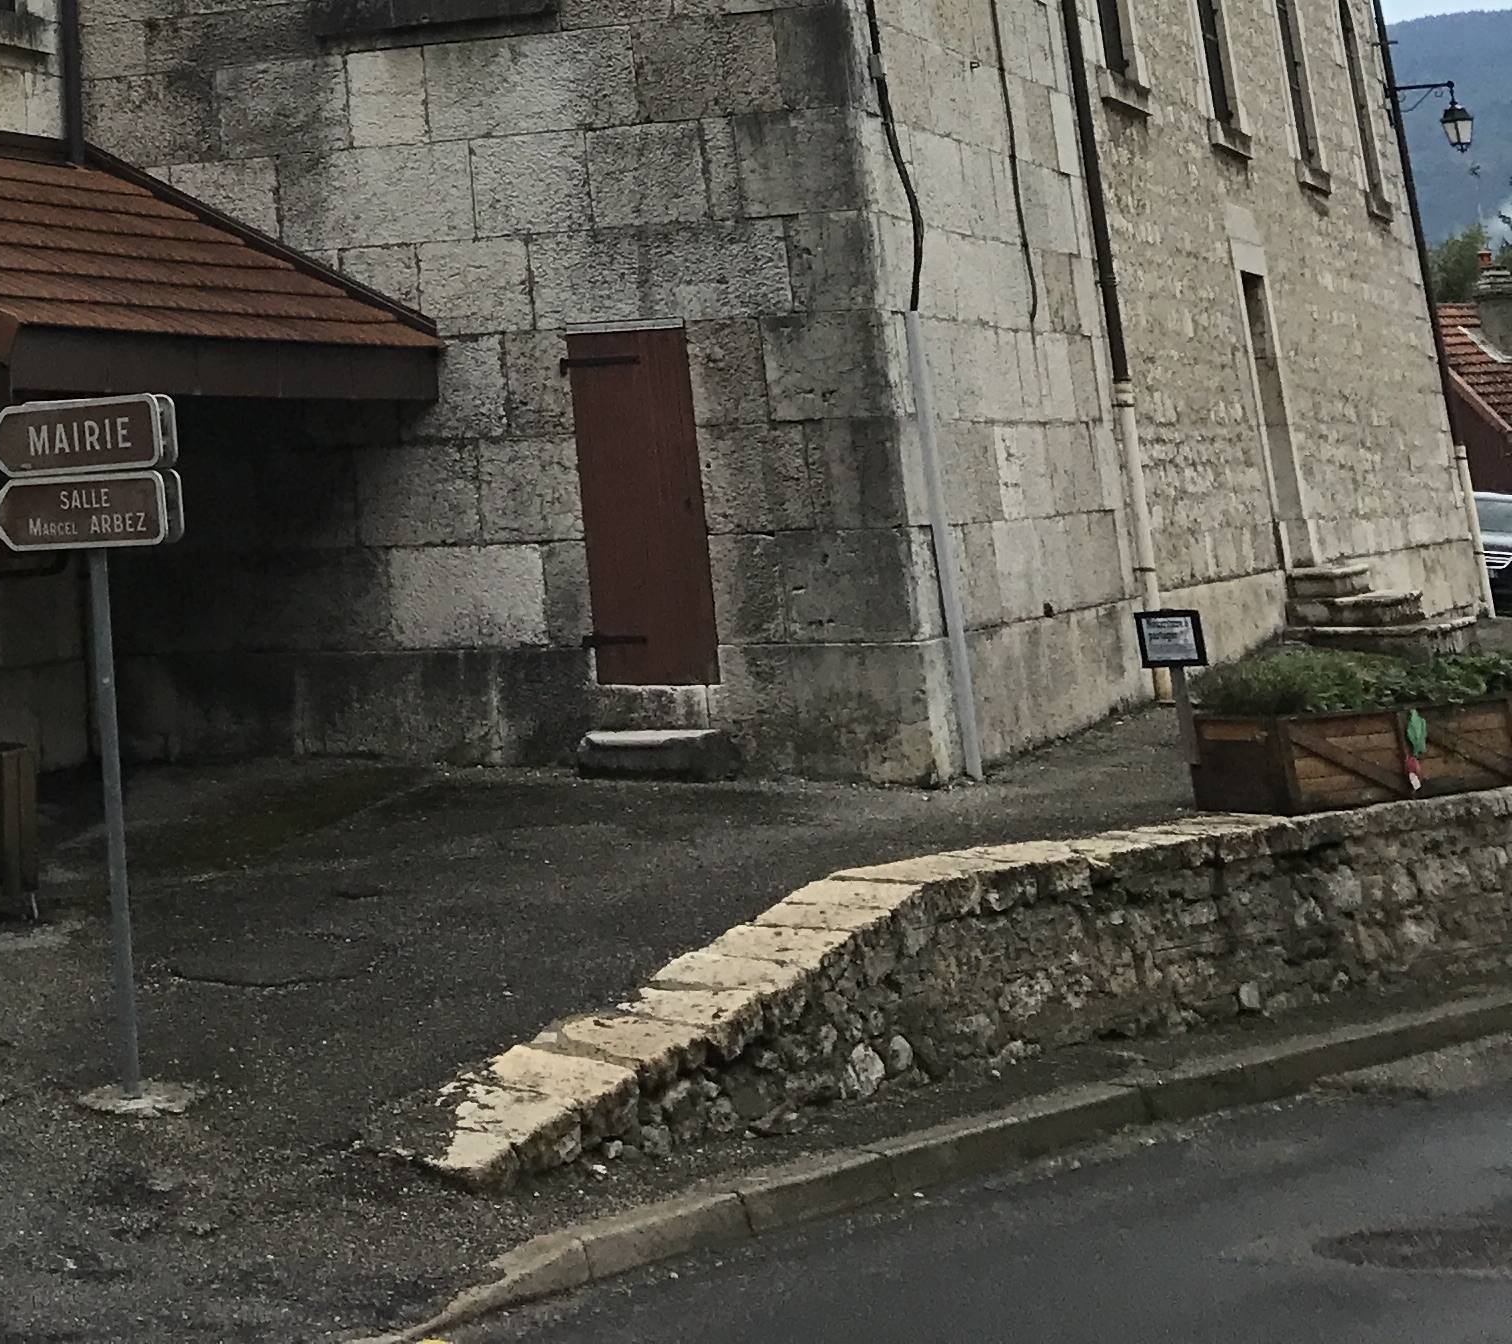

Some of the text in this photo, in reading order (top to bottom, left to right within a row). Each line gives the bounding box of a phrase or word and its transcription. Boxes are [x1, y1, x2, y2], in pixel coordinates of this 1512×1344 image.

[28, 416, 132, 456] MAIRIE
[59, 488, 111, 510] SALLE
[89, 512, 147, 534] ARBEZ
